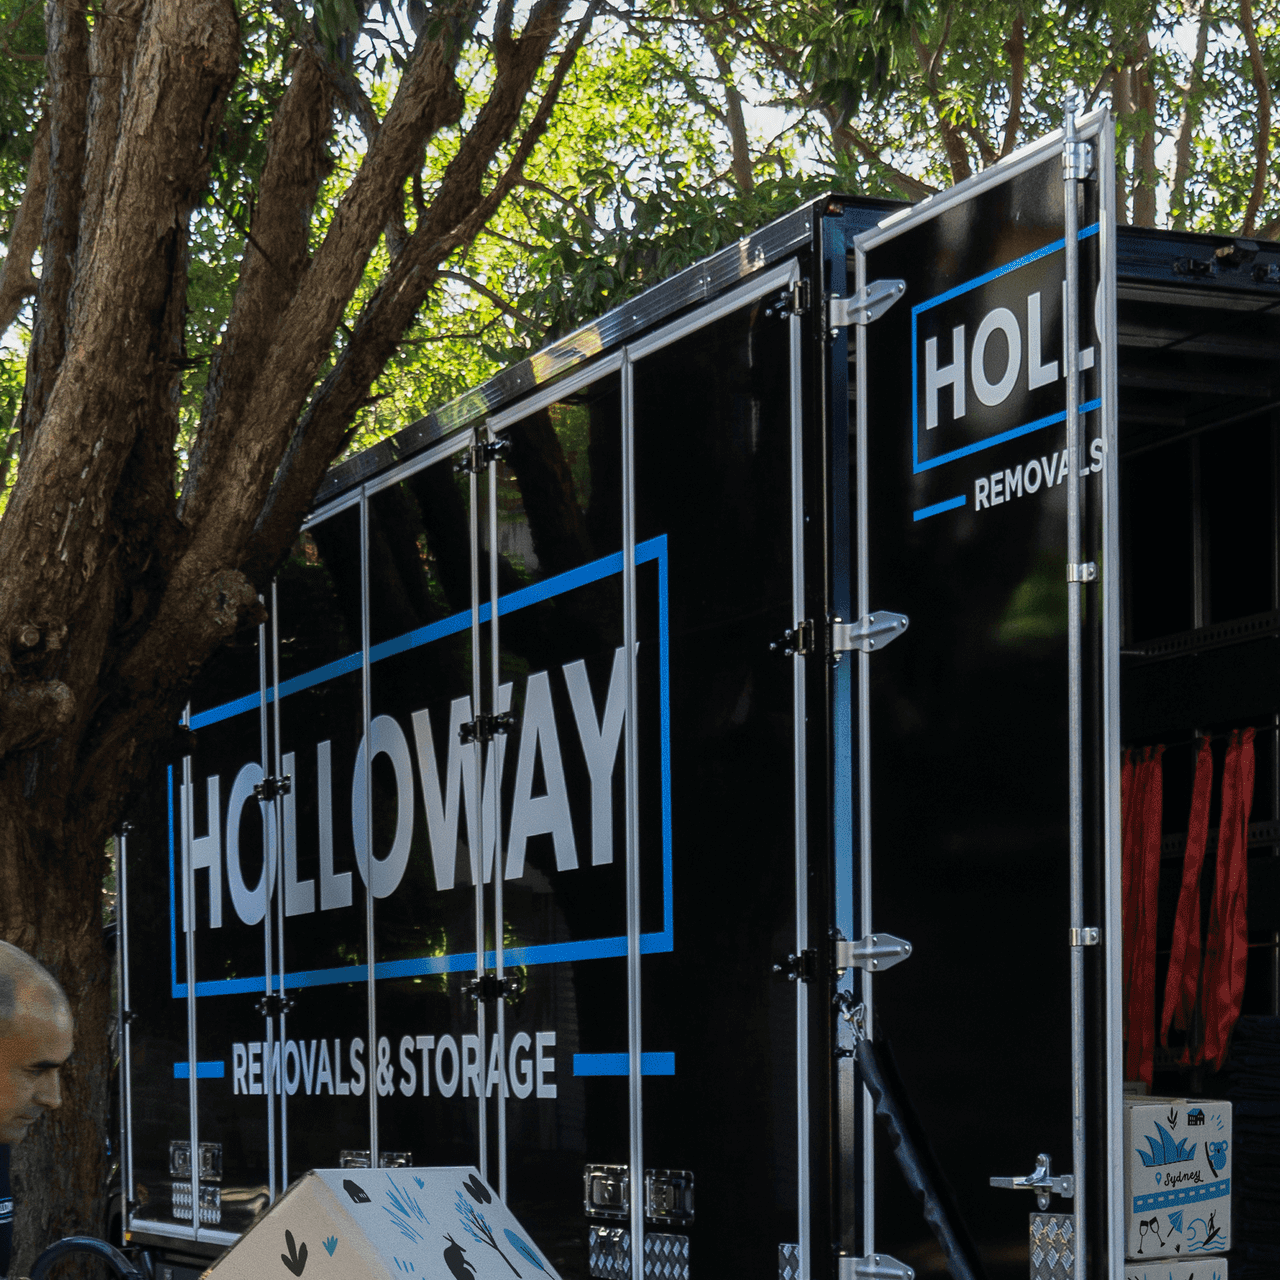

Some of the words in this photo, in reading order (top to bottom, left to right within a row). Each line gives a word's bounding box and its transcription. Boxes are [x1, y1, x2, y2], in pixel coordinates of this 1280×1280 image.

[925, 280, 1102, 431] HOLL
[180, 641, 641, 932] HOLLOWAY
[232, 1037, 365, 1096] REMOVALS
[376, 1036, 395, 1097] &
[399, 1031, 558, 1099] STORAGE
[1163, 1169, 1205, 1188] Sydney
